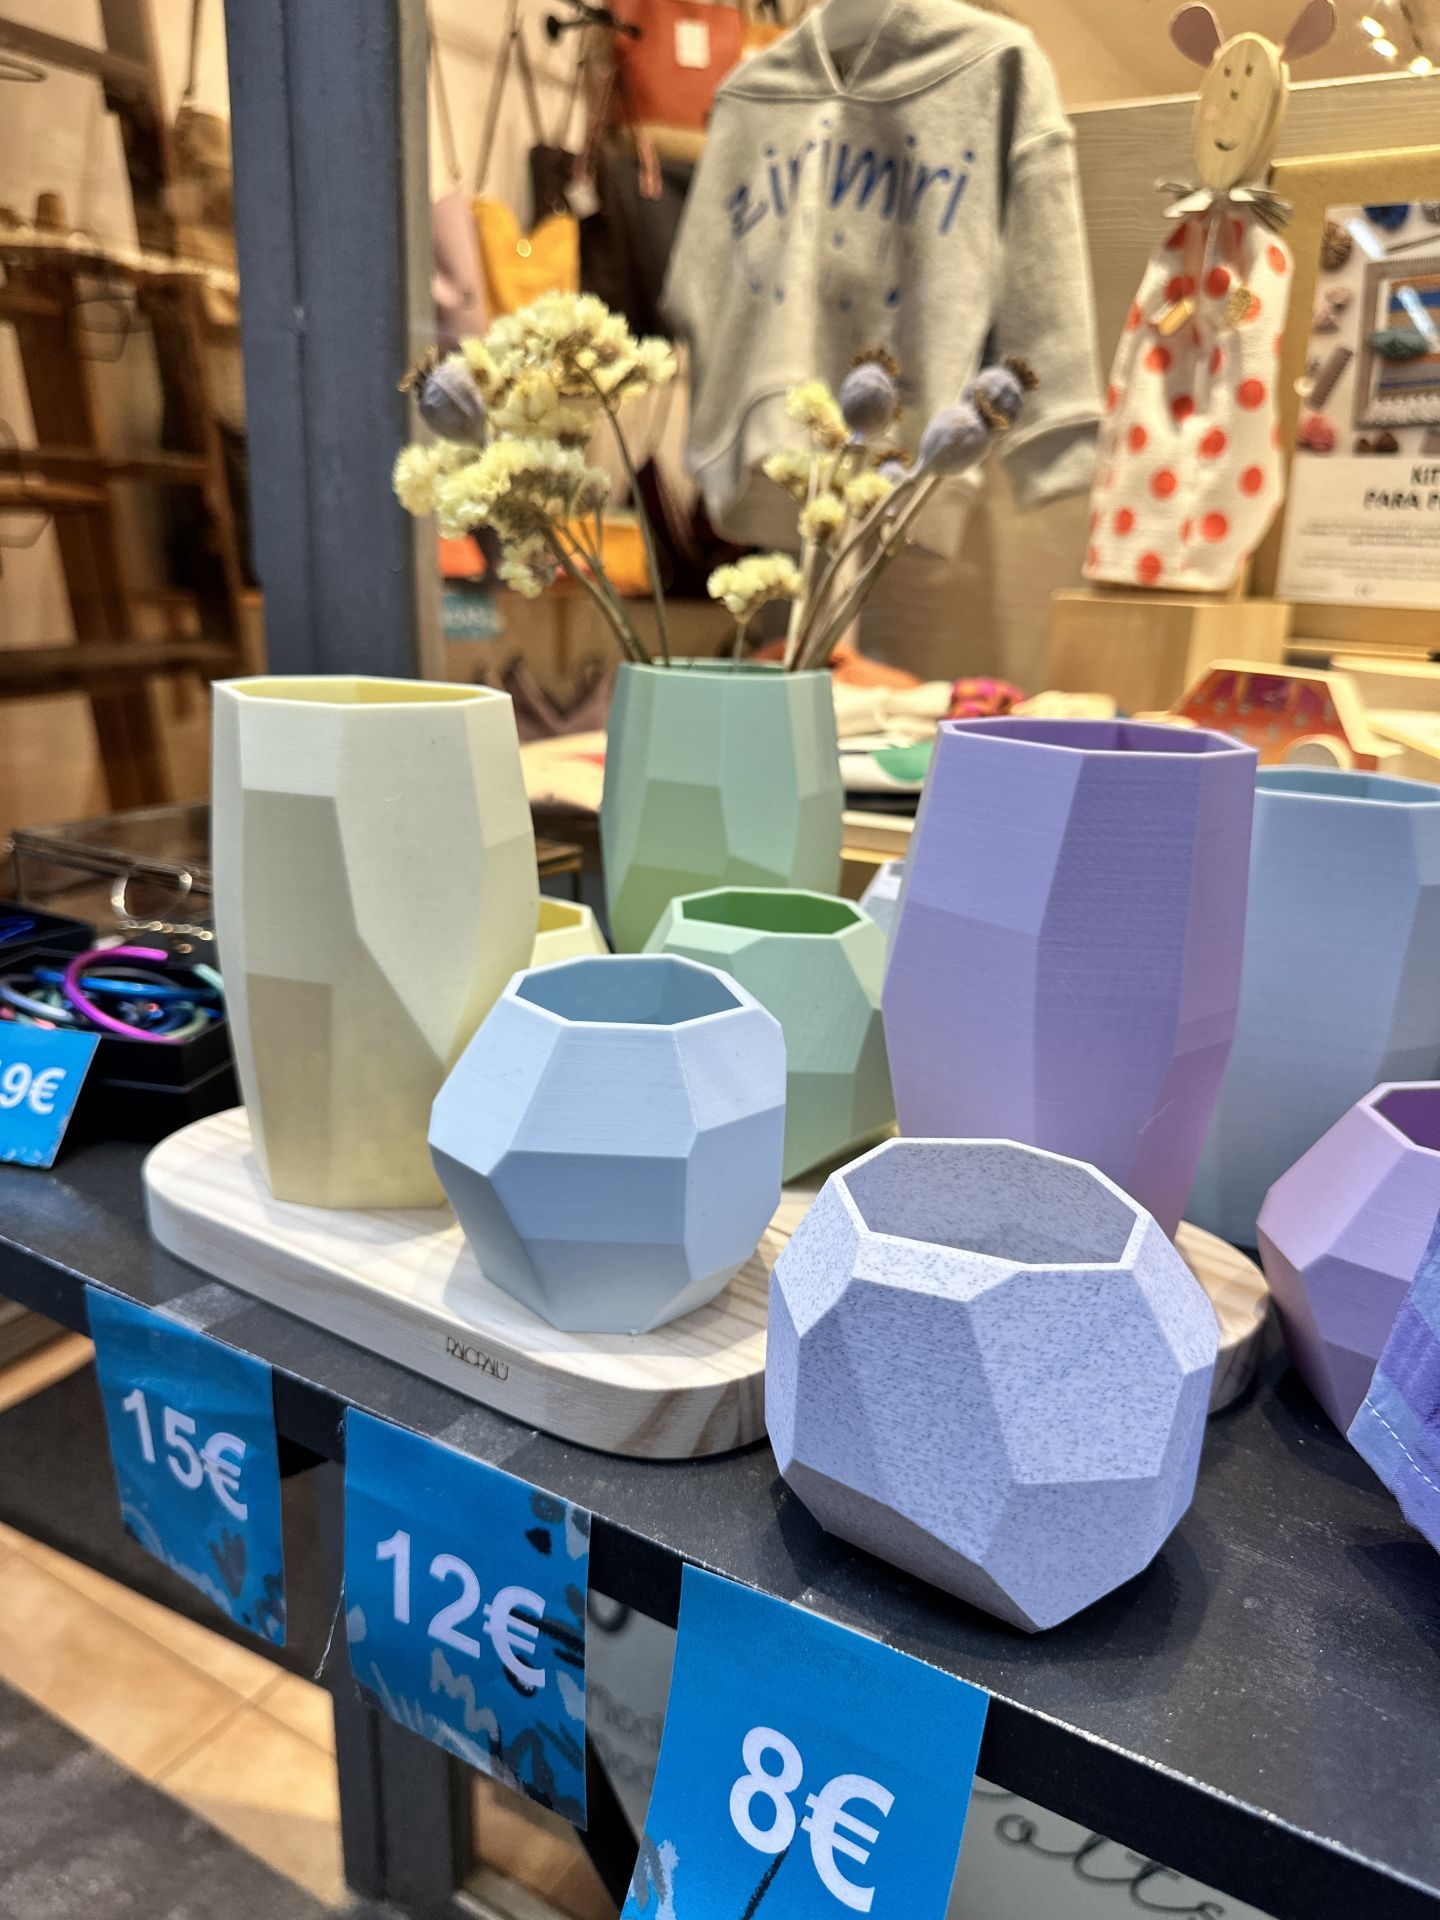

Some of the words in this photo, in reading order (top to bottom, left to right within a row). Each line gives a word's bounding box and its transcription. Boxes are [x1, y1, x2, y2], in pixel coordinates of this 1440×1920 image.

[0, 1059, 67, 1115] 9€
[121, 1388, 248, 1521] 15€
[376, 1529, 546, 1688] 12€
[729, 1726, 896, 1913] 8€
